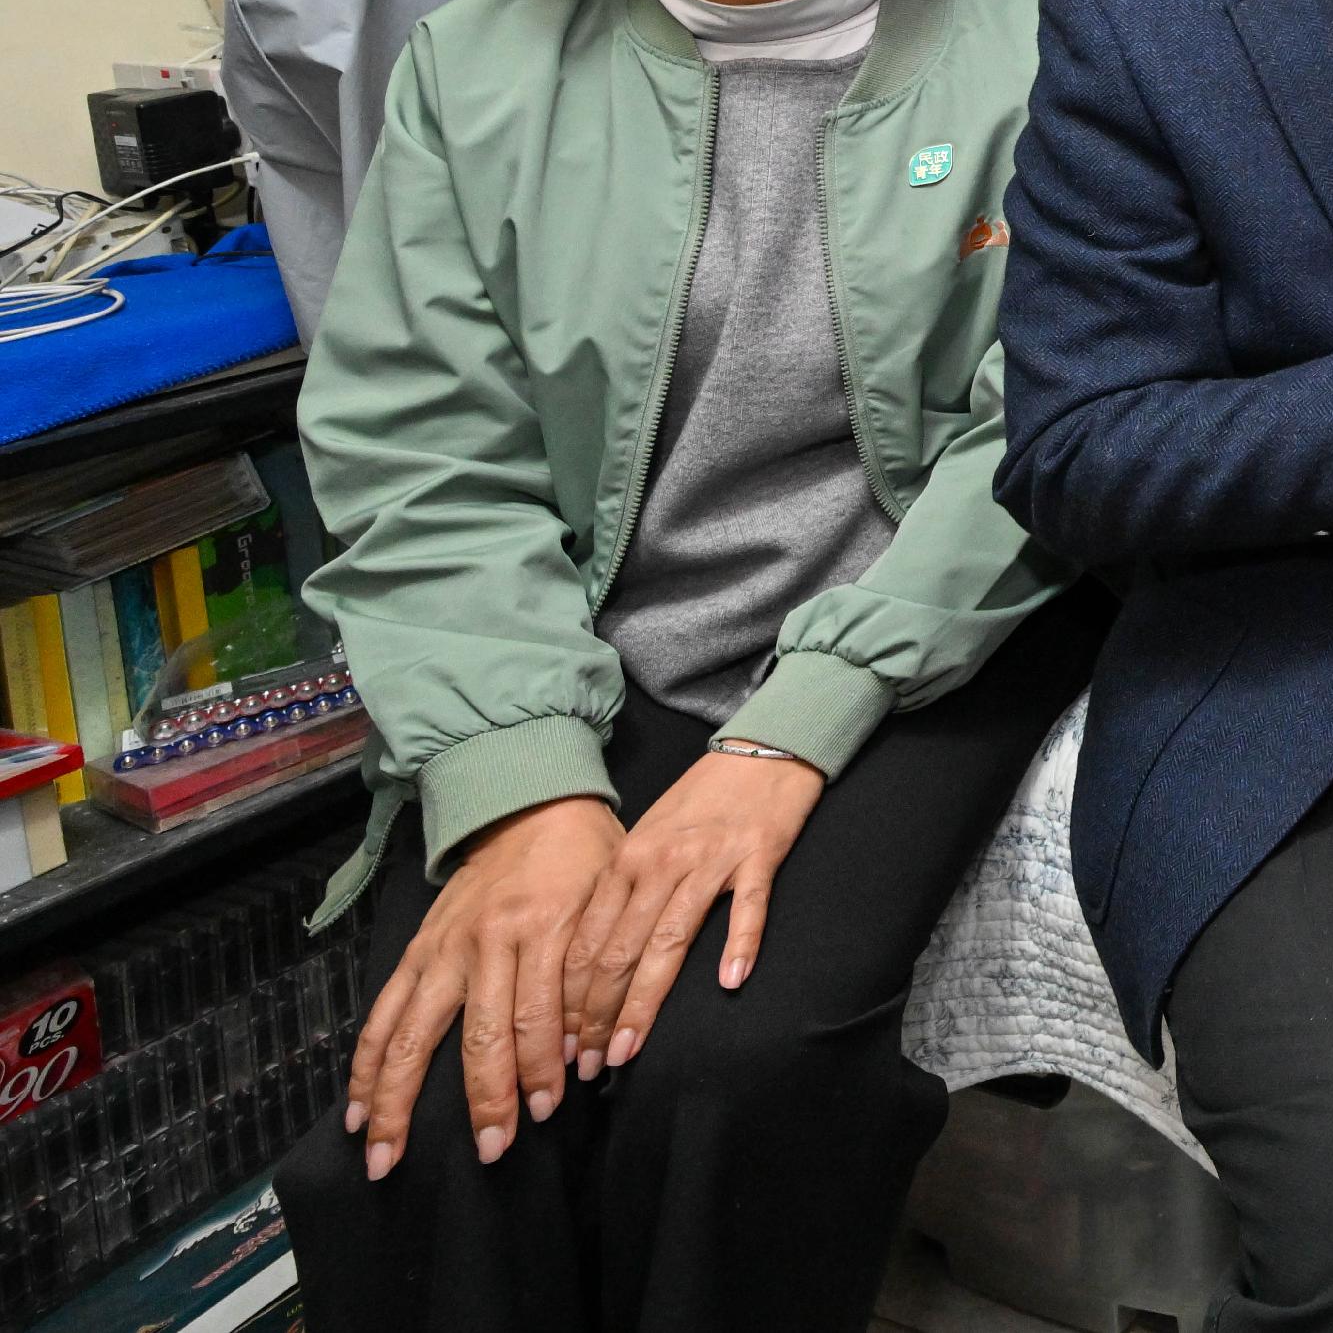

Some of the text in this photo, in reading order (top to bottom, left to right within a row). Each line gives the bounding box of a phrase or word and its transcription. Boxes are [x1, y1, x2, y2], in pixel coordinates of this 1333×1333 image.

[919, 150, 949, 165] 民政
[914, 163, 943, 180] 青年
[32, 1000, 78, 1043] 10
[28, 1029, 65, 1055] PCS.
[0, 1045, 79, 1121] 90
